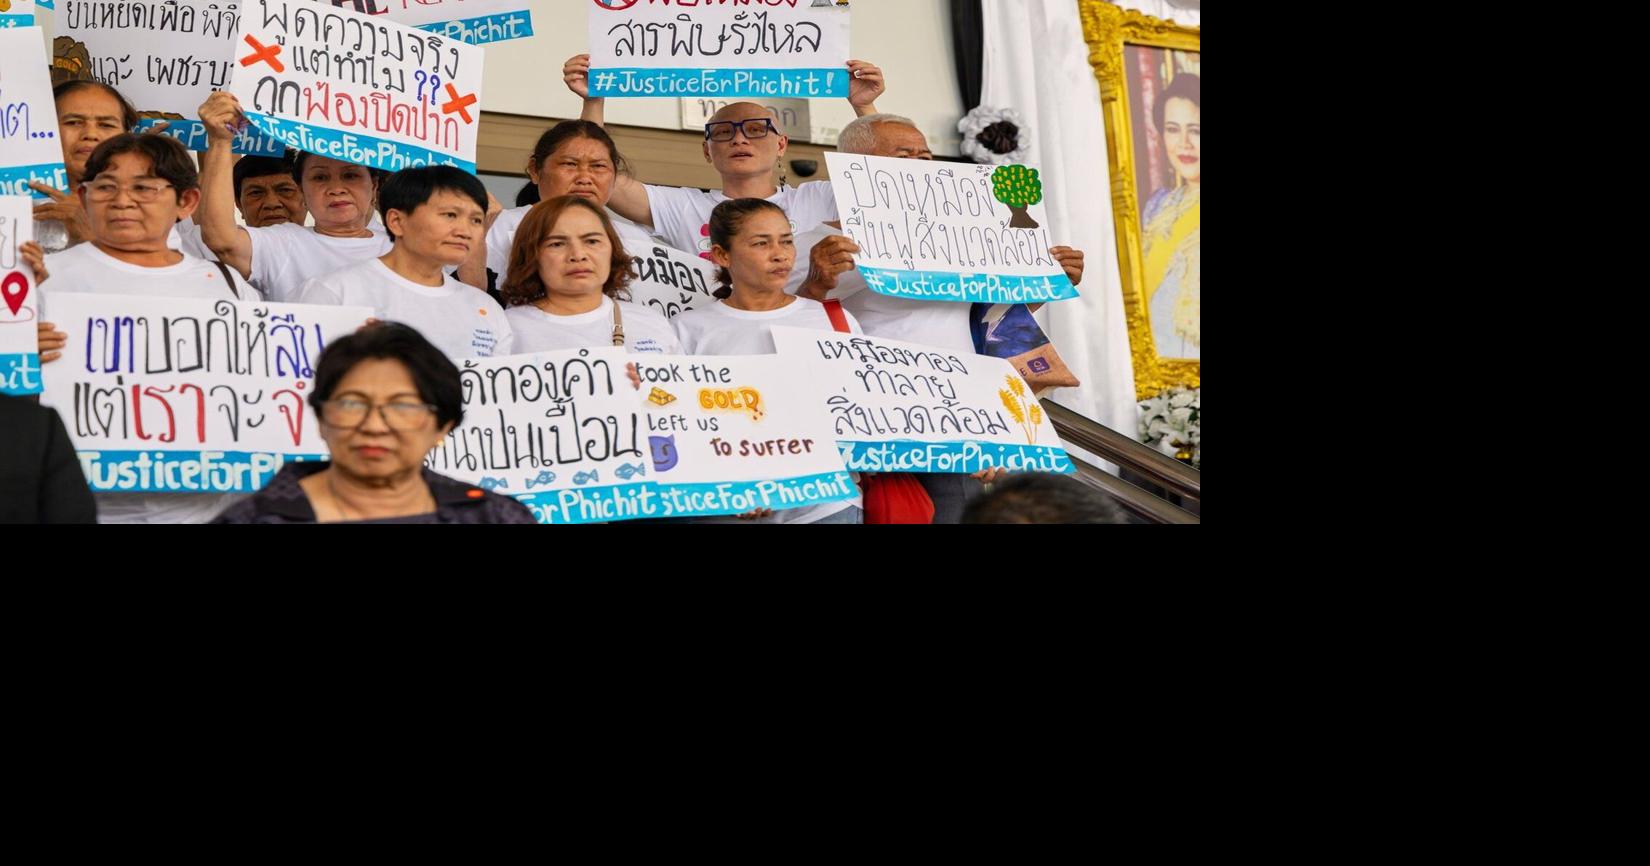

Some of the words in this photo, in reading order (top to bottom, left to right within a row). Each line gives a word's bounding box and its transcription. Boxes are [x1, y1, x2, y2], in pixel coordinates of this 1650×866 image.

[607, 11, 822, 57] สารพิษรั่วไหล
[93, 54, 134, 86] และ
[292, 44, 405, 93] แต่ทำไม
[844, 156, 996, 218] ปิดเหมือง
[866, 270, 1063, 300] #JusticeForPhichit
[690, 364, 732, 384] the
[817, 337, 969, 376] เหมืองทอง
[854, 364, 957, 400] ทำลาย
[74, 375, 306, 447] แต่เราจะจ
[699, 389, 761, 413] GOLD
[826, 386, 1011, 436] สิ่งแวดล้อม
[697, 416, 720, 432] us
